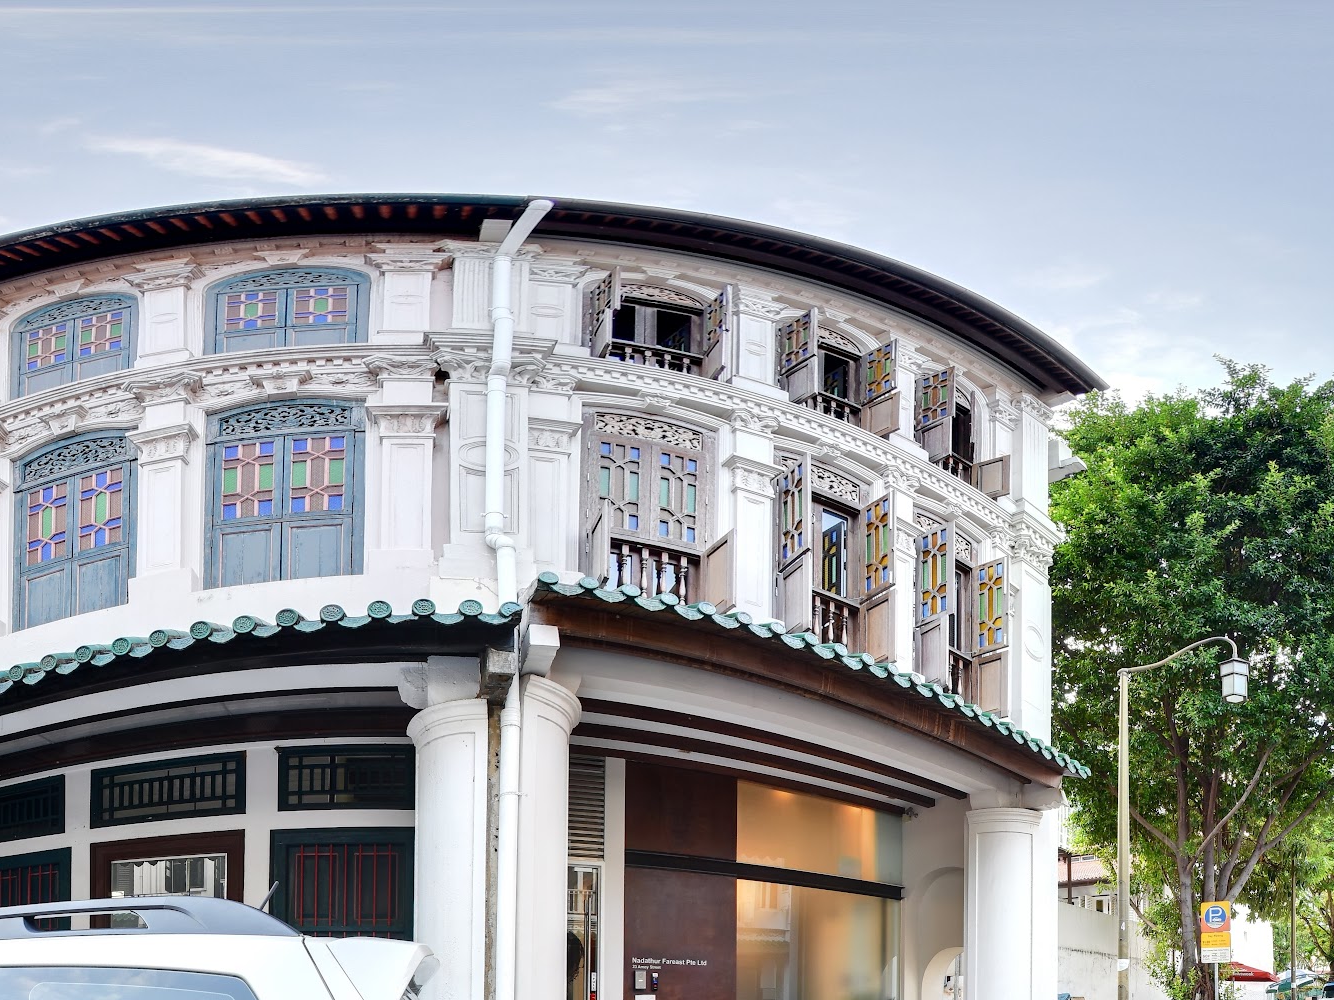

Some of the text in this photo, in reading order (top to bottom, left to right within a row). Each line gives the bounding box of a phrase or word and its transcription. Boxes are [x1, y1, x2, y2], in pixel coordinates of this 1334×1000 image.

[1120, 921, 1126, 930] 4
[632, 957, 661, 965] Nadathur
[662, 958, 685, 966] Fareast
